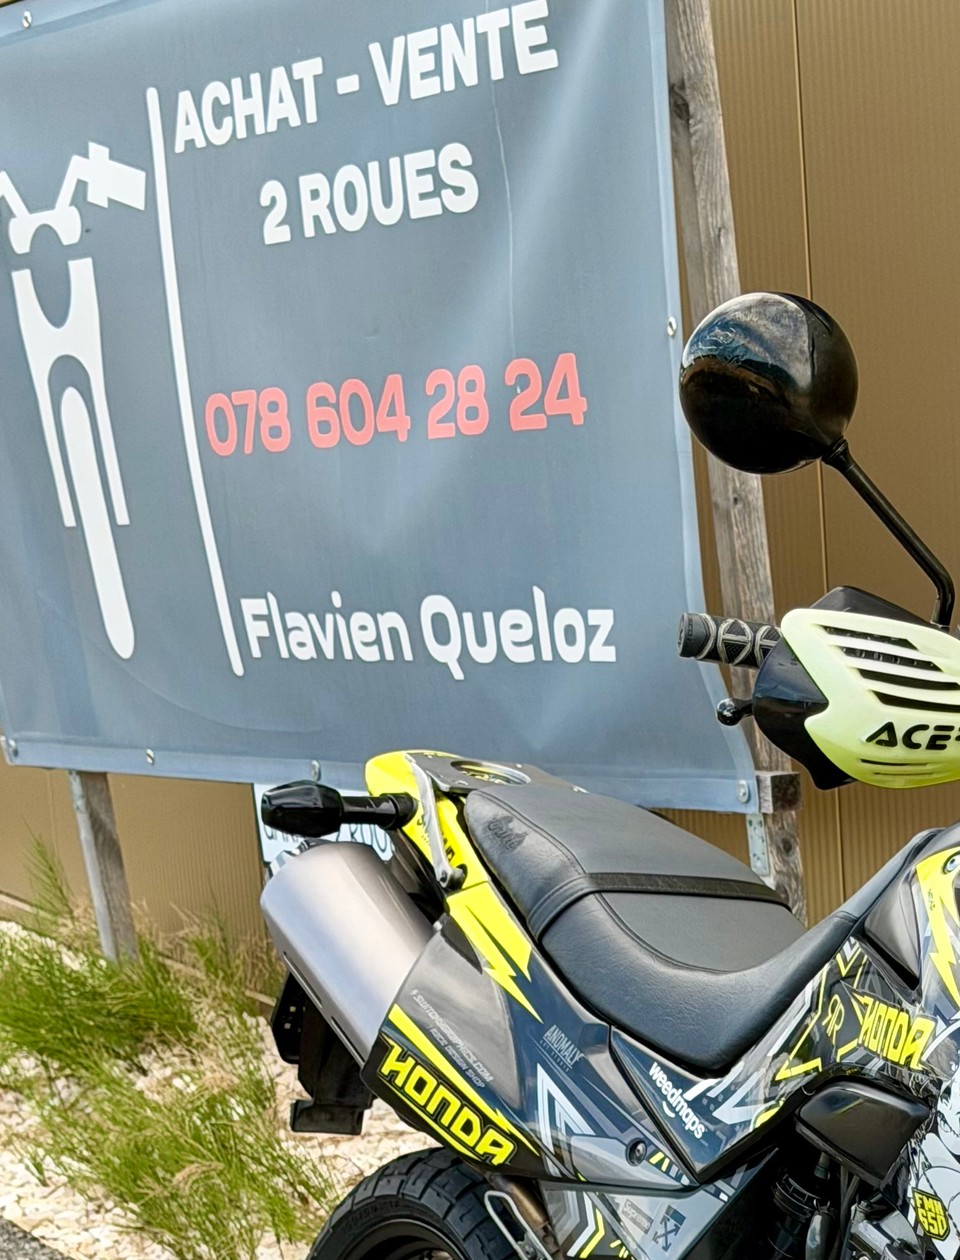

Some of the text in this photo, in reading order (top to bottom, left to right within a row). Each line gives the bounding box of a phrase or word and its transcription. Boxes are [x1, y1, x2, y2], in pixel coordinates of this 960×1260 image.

[174, 56, 323, 154] ACHAT
[368, 0, 559, 106] VENTE
[259, 142, 479, 245] 2 ROUES
[205, 353, 587, 456] 078 604 28 24
[240, 585, 616, 680] Flavien Queloz
[543, 1024, 586, 1065] ANOMALY
[856, 993, 938, 1071] HONDA
[379, 1040, 515, 1166] HONDA
[648, 1061, 706, 1140] weedmaps
